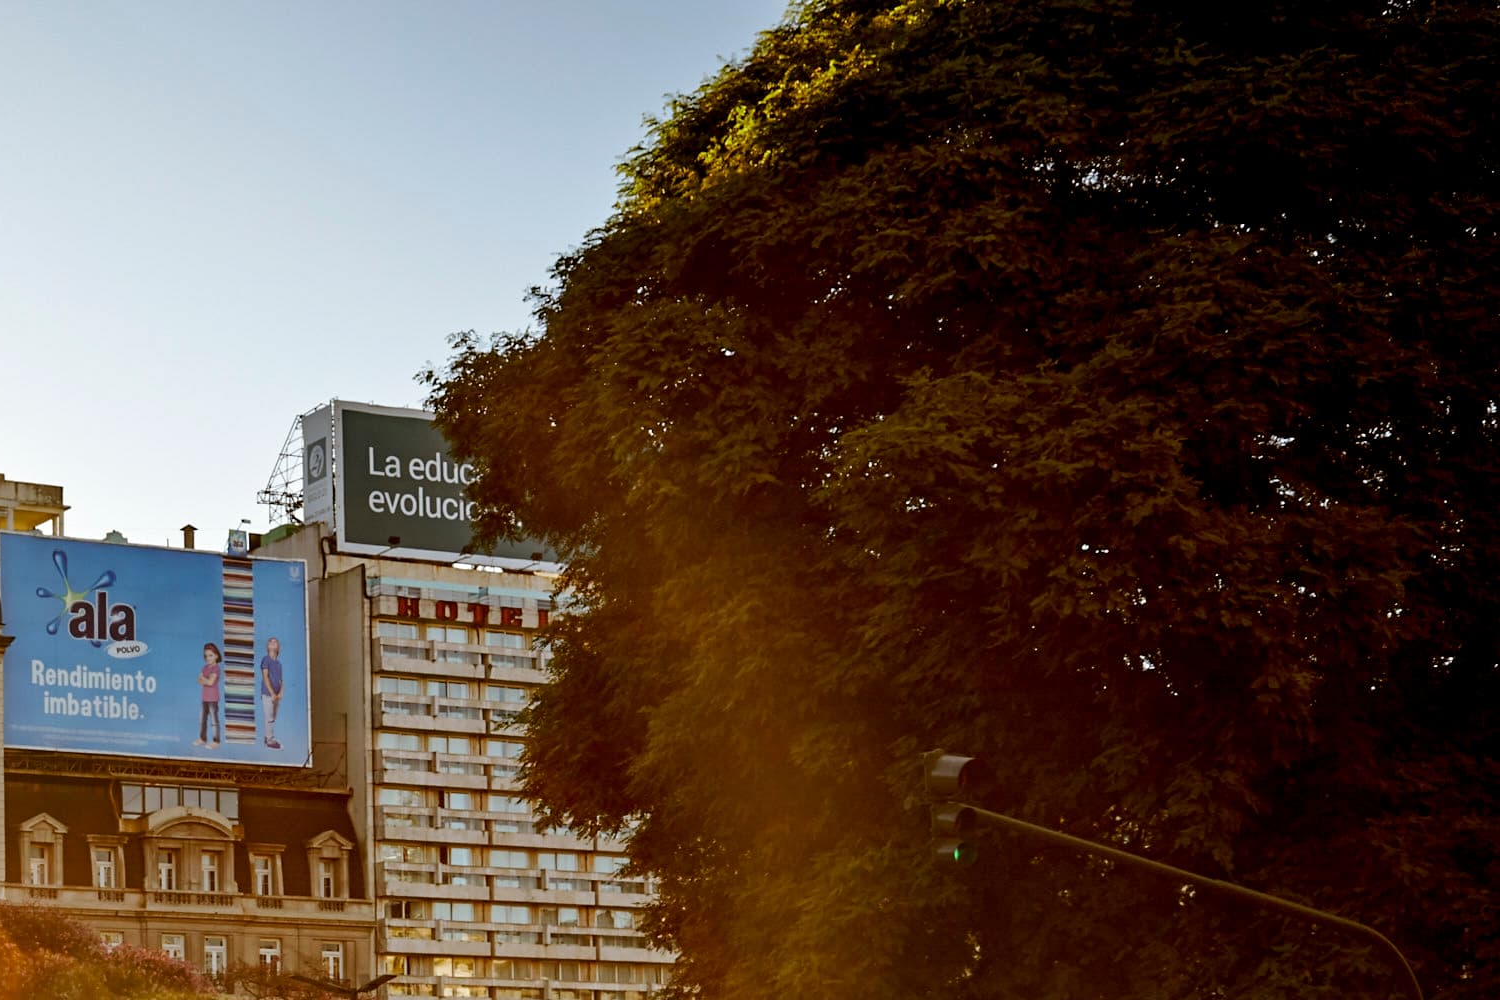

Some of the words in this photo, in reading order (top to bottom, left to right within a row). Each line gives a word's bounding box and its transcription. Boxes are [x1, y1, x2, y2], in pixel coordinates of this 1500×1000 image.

[368, 446, 401, 478] La
[408, 452, 484, 486] educ
[69, 591, 136, 642] ala
[115, 645, 141, 655] POLVO
[31, 659, 157, 693] Rendimiento
[43, 691, 145, 720] imbatible.
